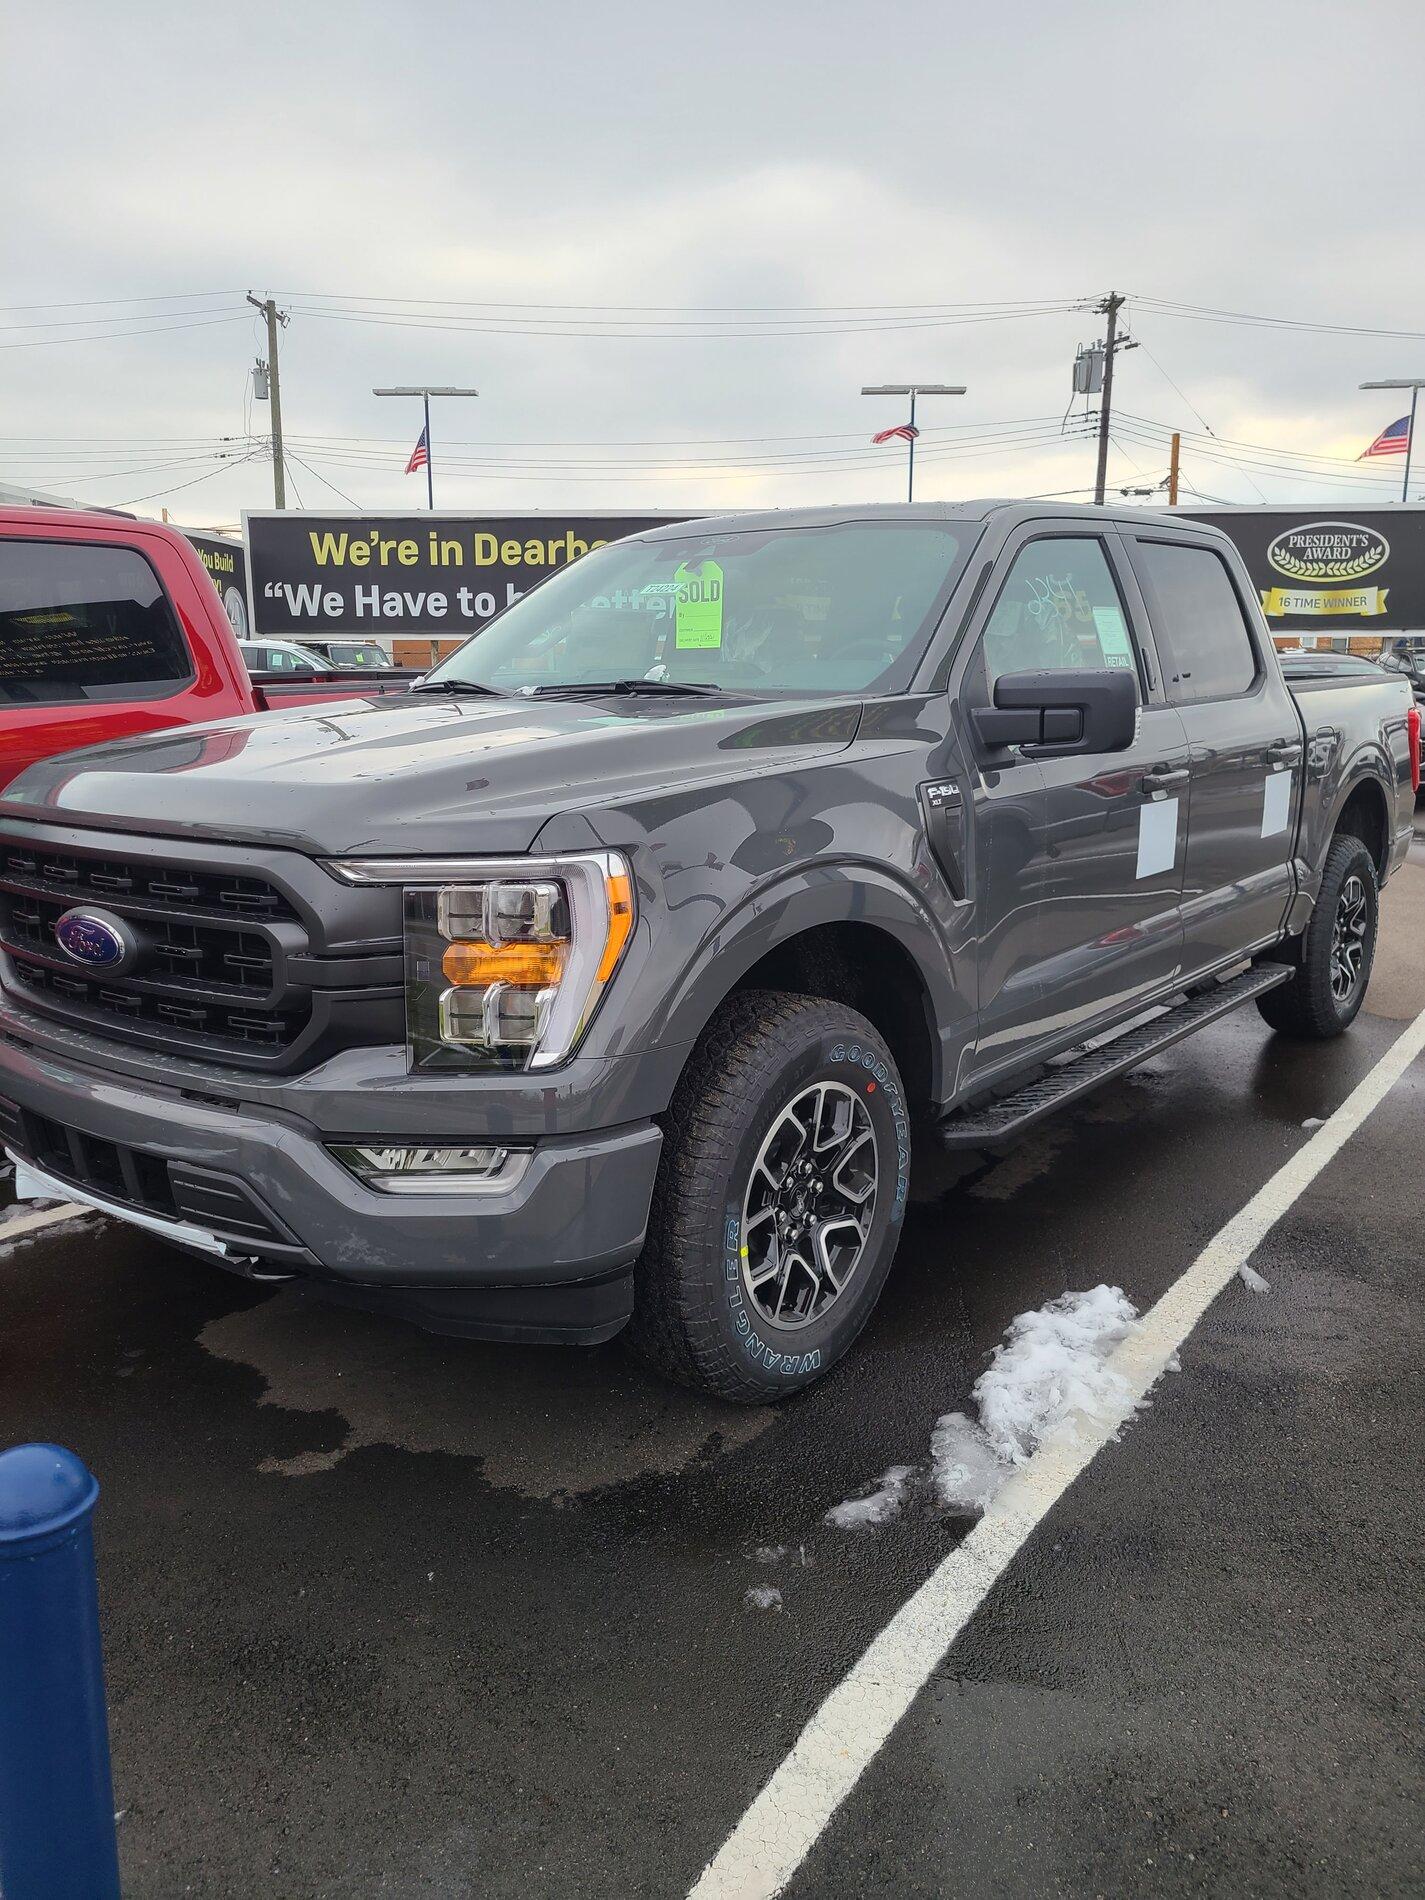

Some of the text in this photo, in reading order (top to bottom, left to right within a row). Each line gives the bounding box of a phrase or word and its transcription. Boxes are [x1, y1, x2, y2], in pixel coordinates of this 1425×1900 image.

[309, 530, 419, 566] We're
[429, 531, 464, 566] in
[1288, 533, 1370, 548] PRESIDENT'S
[214, 551, 235, 573] Build
[1302, 547, 1352, 560] AWARD
[354, 584, 449, 617] Have
[456, 586, 497, 617] to
[678, 579, 720, 604] SOLD
[1278, 595, 1368, 609] 16 TIME WINNER
[830, 1043, 910, 1202] GOODYEAR
[724, 1219, 822, 1376] WRANGLER
